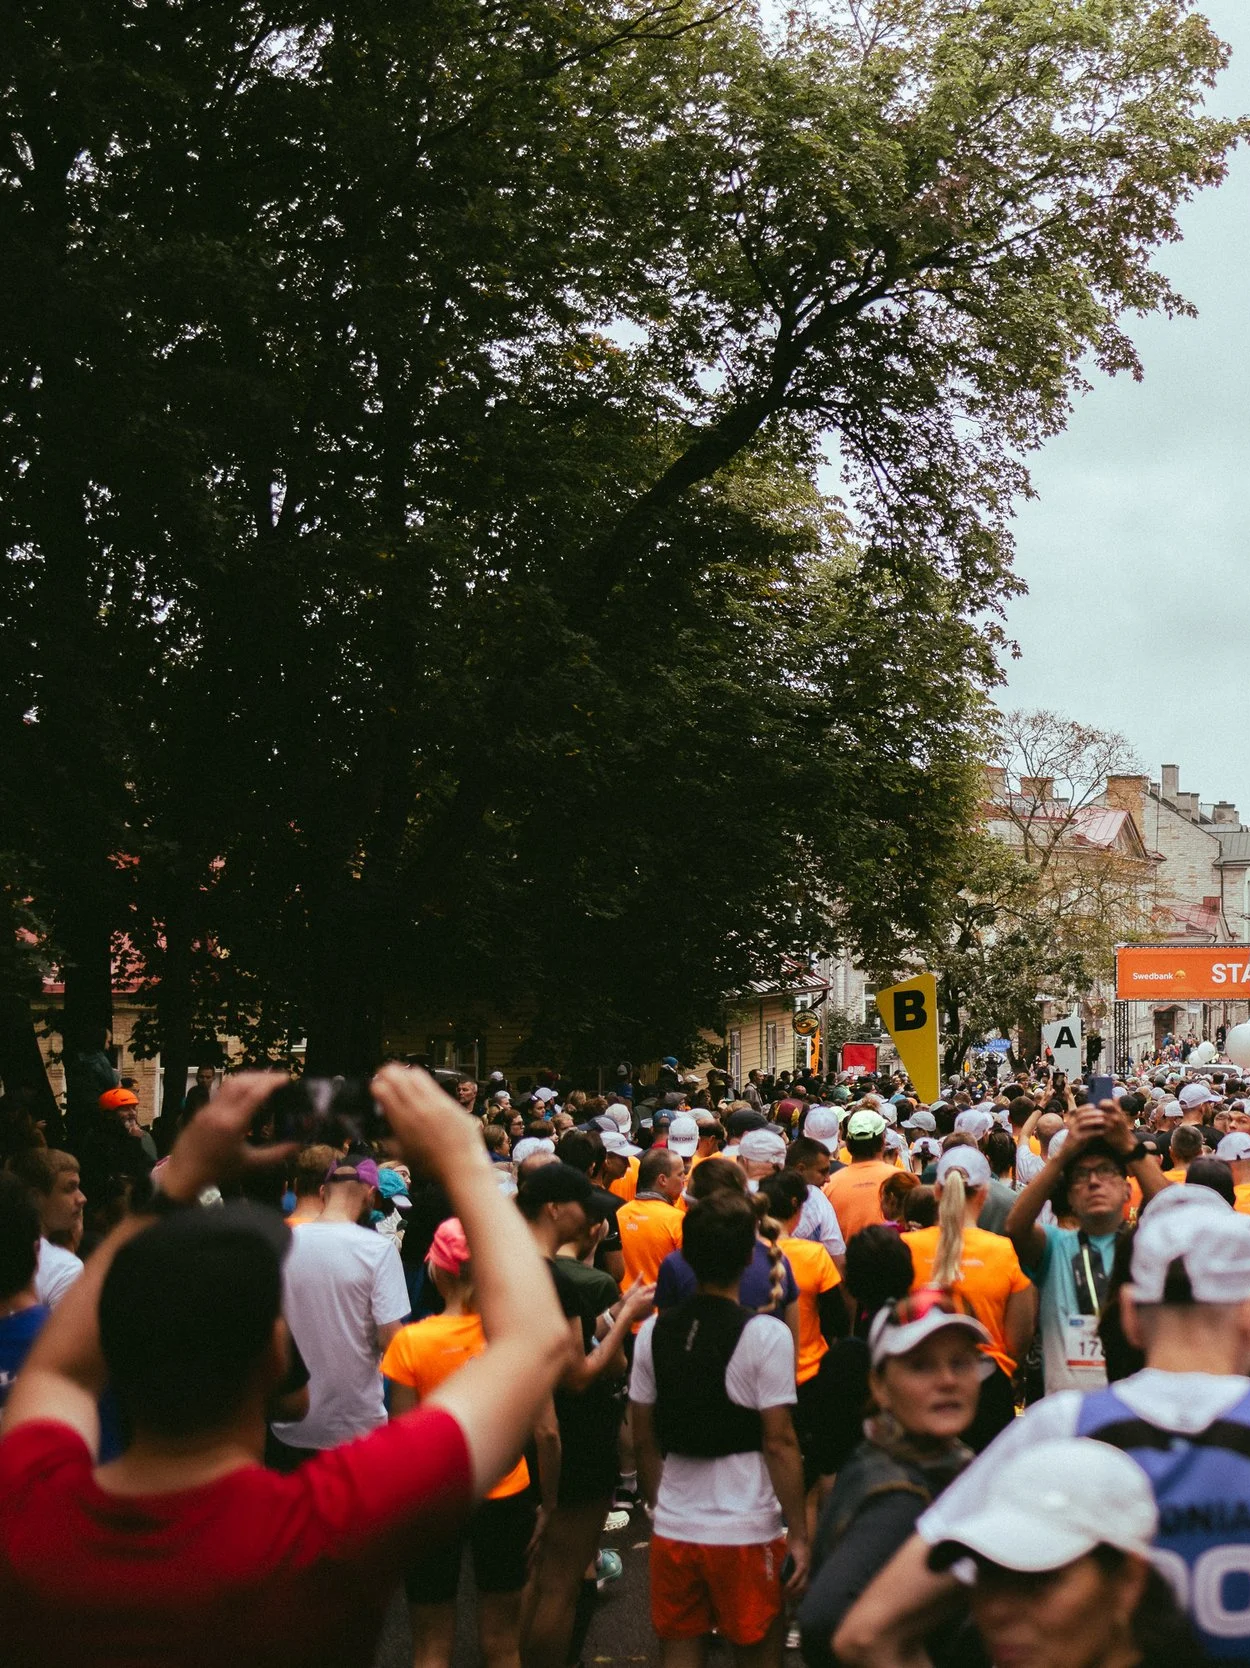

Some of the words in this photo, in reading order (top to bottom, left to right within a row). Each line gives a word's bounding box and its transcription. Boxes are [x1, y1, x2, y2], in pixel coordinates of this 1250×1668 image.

[1132, 971, 1174, 980] Swedbank
[1211, 963, 1250, 983] STA
[893, 989, 928, 1032] B
[1054, 1026, 1077, 1048] A
